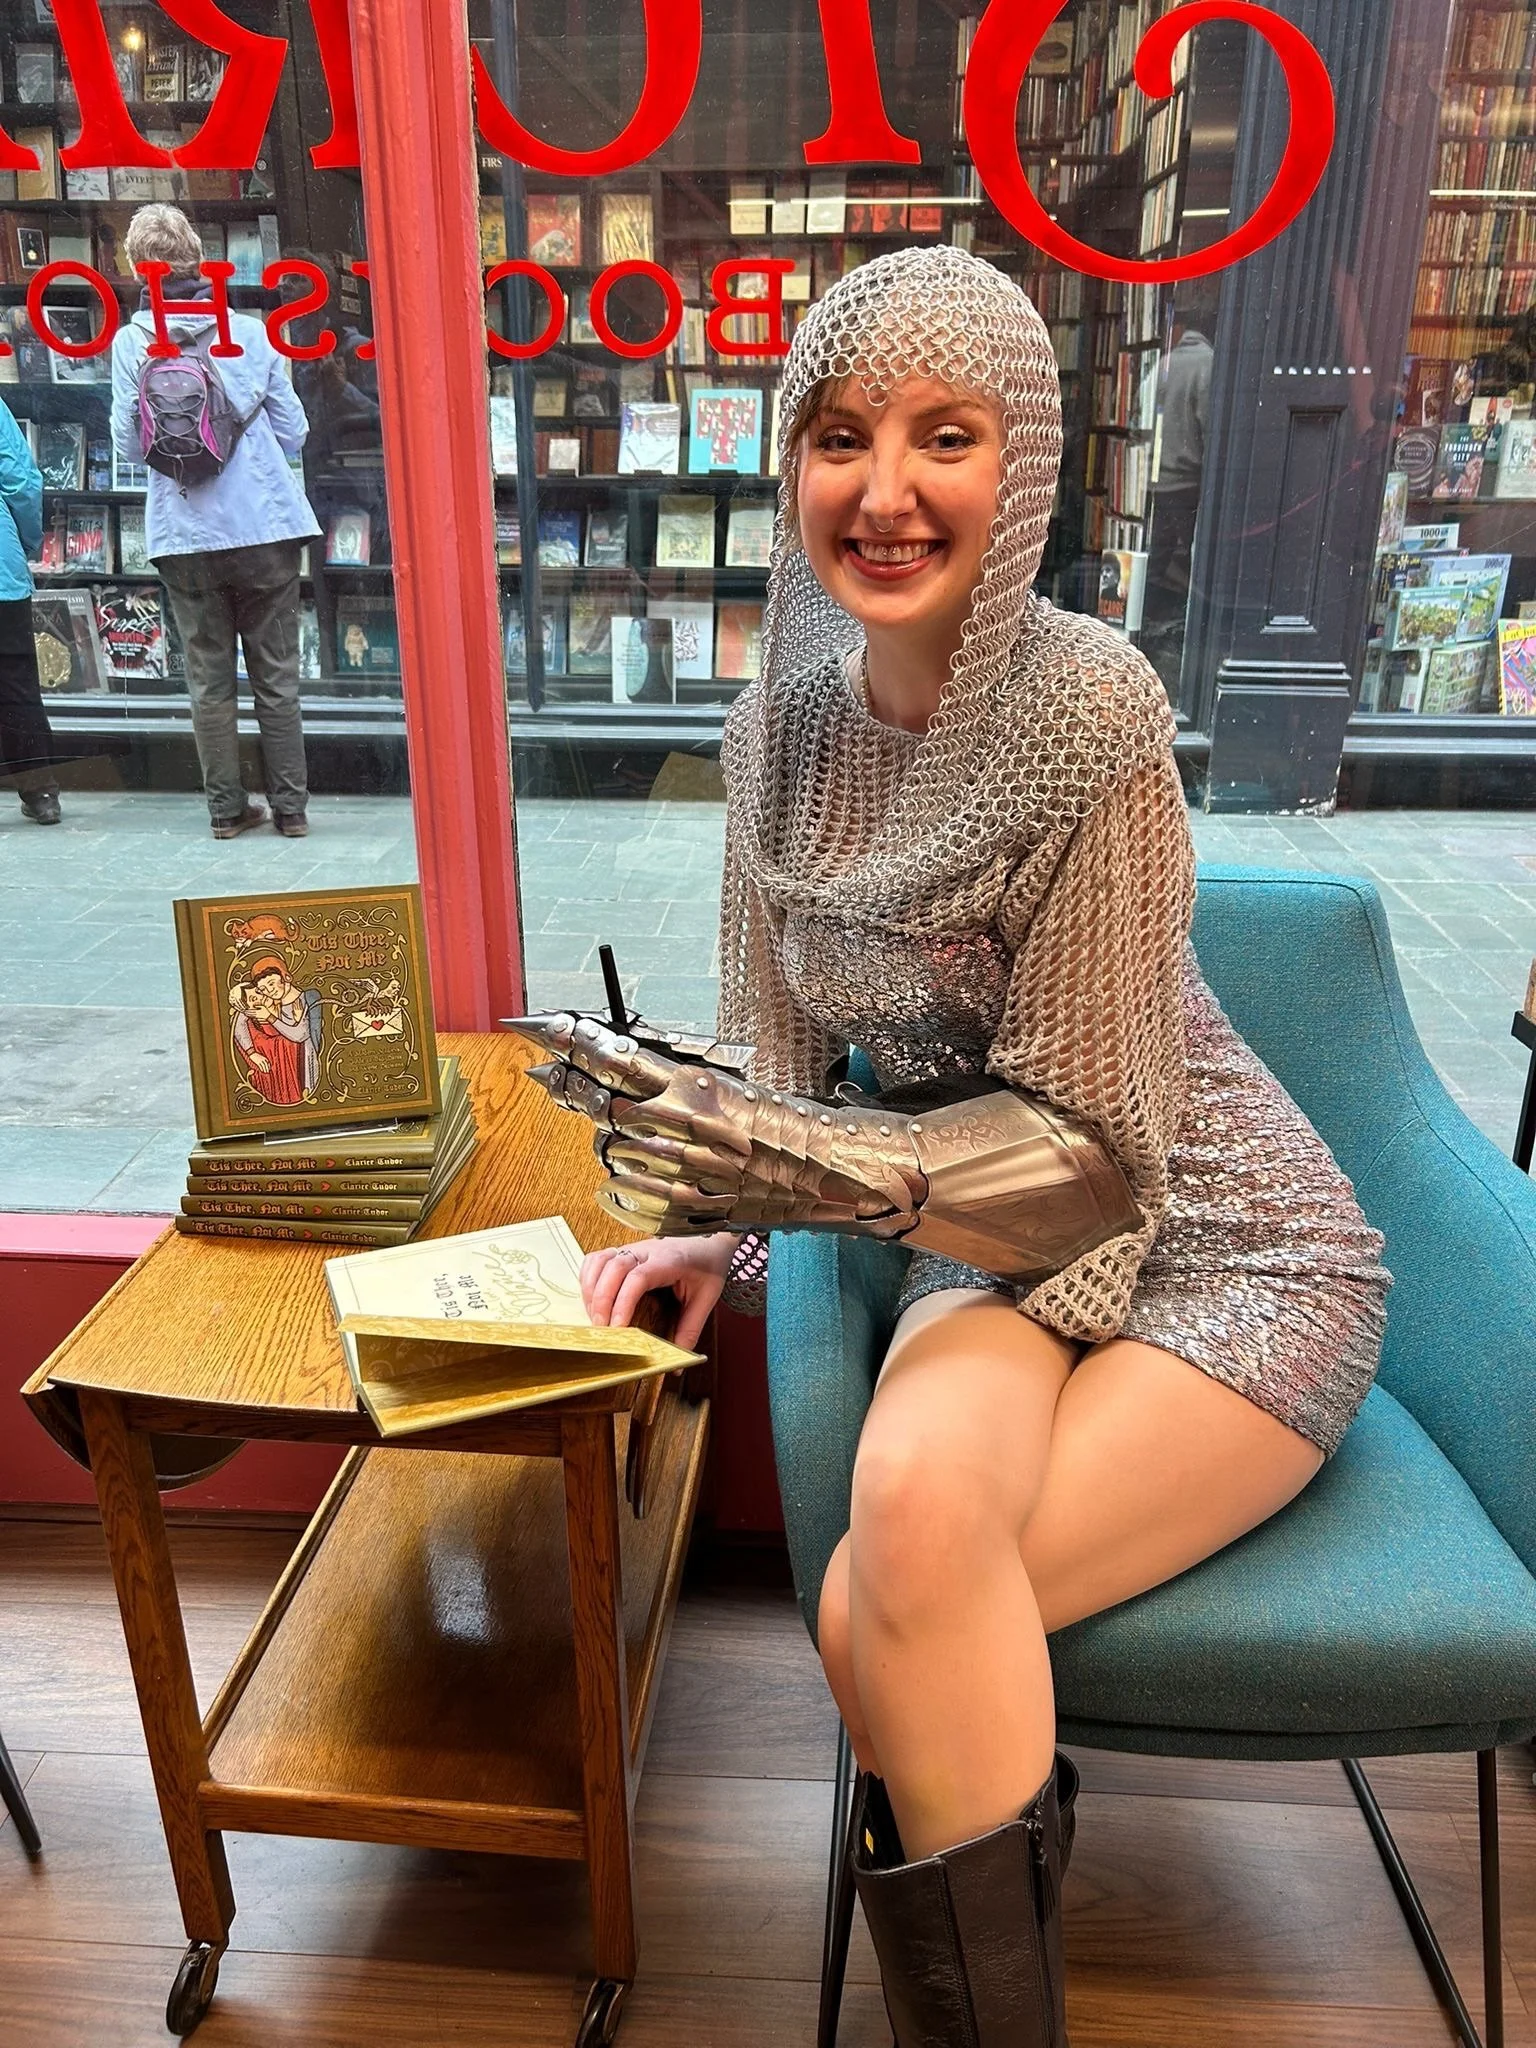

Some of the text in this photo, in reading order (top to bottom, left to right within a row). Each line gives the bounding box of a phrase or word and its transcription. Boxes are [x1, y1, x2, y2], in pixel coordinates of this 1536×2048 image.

[481, 157, 503, 168] FIRS
[1420, 527, 1440, 538] 1000
[300, 930, 389, 952] 'Tis Thee,
[315, 950, 386, 972] Not Me
[234, 1159, 265, 1171] Thee,
[270, 1159, 293, 1170] Not
[296, 1158, 317, 1169] Me
[345, 1158, 374, 1167] Clarice
[377, 1157, 403, 1165] Tudor
[231, 1180, 262, 1192] Thee,
[266, 1181, 289, 1192] Not
[292, 1181, 312, 1191] Me
[340, 1181, 369, 1190] Clarice
[371, 1181, 398, 1190] Tudor
[225, 1202, 256, 1214] Thee,
[260, 1203, 282, 1214] Not
[286, 1204, 304, 1214] Me
[332, 1206, 360, 1215] Clarice
[363, 1207, 389, 1216] Tudor
[218, 1223, 247, 1235] Thee,
[252, 1225, 273, 1237] Not
[276, 1227, 295, 1238] Me
[321, 1231, 349, 1240] Clarice
[351, 1233, 377, 1243] Tudor
